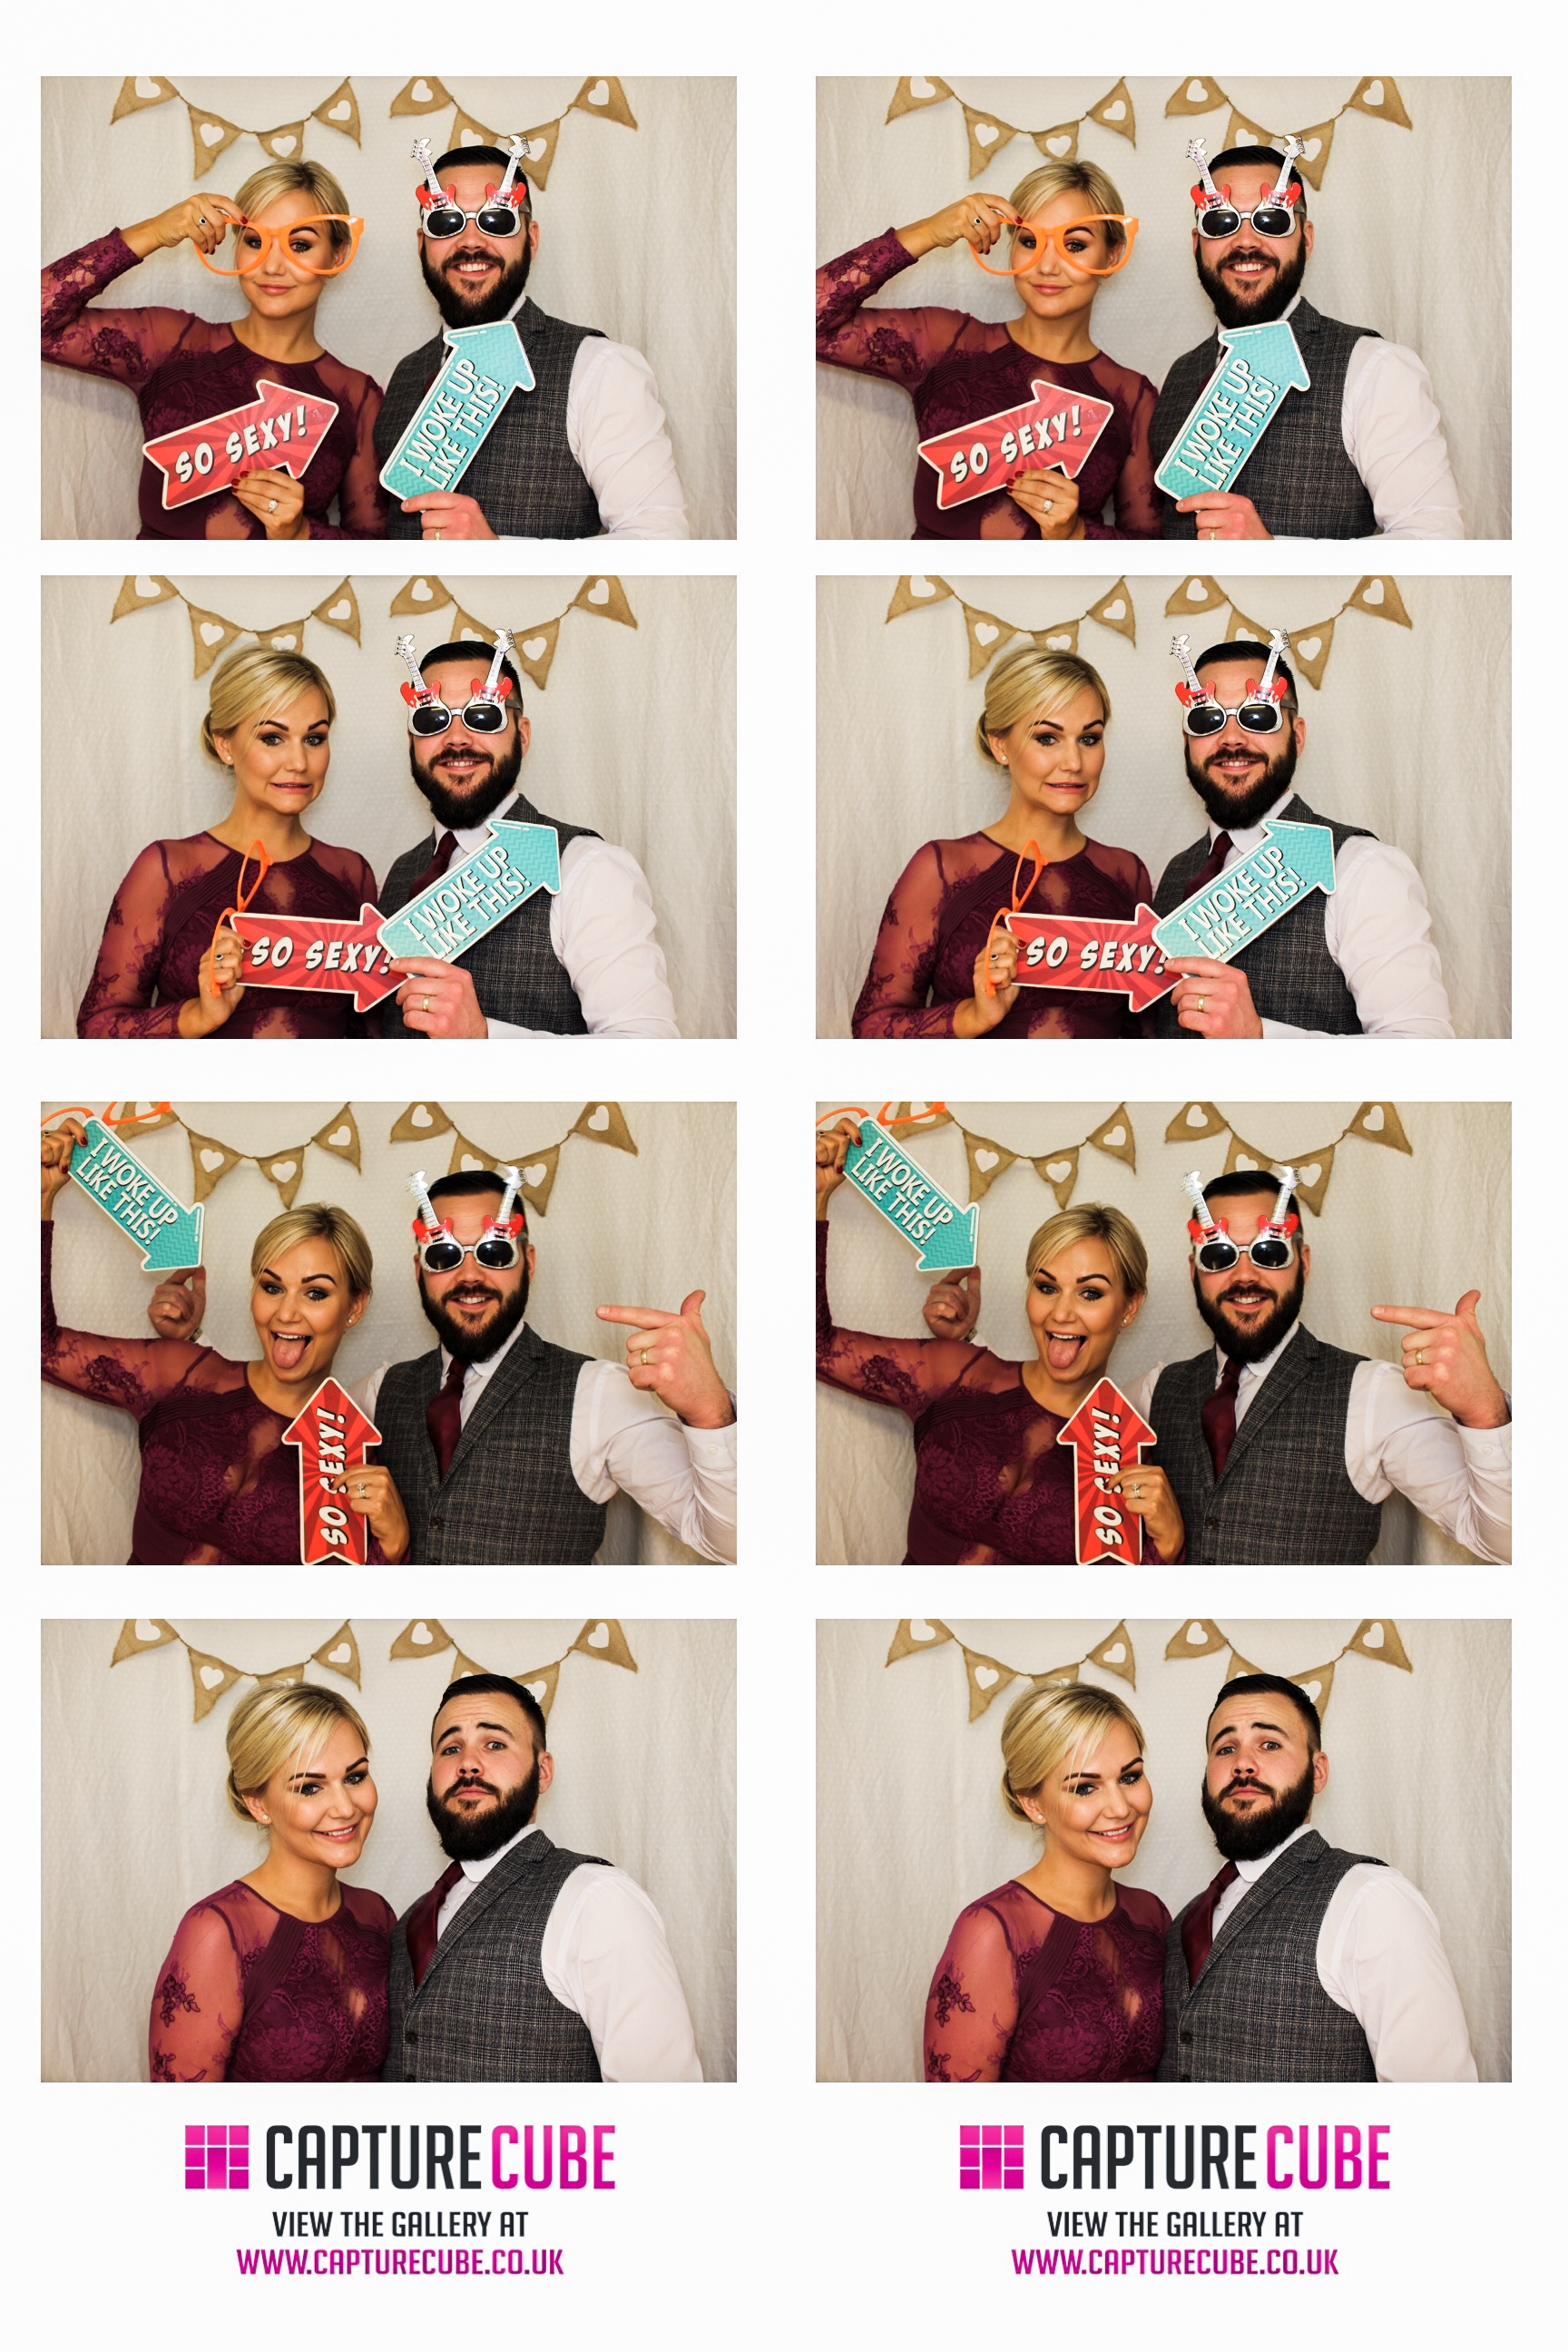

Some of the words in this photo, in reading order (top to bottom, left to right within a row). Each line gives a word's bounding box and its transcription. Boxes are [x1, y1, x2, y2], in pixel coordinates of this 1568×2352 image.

[446, 358, 480, 395] UP
[1221, 358, 1255, 395] UP
[175, 442, 214, 483] SO
[225, 405, 307, 464] SEXY!
[406, 391, 465, 463] WOKE
[423, 437, 469, 490] LIKE
[452, 375, 506, 438] THIS!
[950, 442, 989, 483] SO
[1000, 405, 1082, 464] SEXY!
[1181, 391, 1240, 463] WOKE
[1198, 437, 1244, 490] LIKE
[1227, 375, 1281, 438] THIS!
[399, 457, 425, 477] I
[1174, 457, 1200, 477] I
[475, 846, 510, 879] UP
[1250, 846, 1285, 879] UP
[403, 917, 426, 941] I
[413, 868, 487, 930] WOKE
[422, 913, 477, 960] LIKE
[467, 867, 532, 921] THIS!
[1178, 917, 1200, 941] I
[1188, 868, 1262, 930] WOKE
[1197, 913, 1252, 960] LIKE
[1242, 867, 1307, 921] THIS!
[251, 936, 294, 967] SO
[1026, 936, 1069, 967] SO
[76, 1156, 118, 1201] LIKE
[113, 1191, 162, 1246] THIS!
[90, 1137, 108, 1158] I
[101, 1145, 155, 1207] WOKE
[149, 1195, 179, 1226] UP
[851, 1156, 893, 1201] LIKE
[887, 1191, 936, 1246] THIS!
[865, 1137, 883, 1158] I
[876, 1145, 930, 1207] WOKE
[924, 1195, 954, 1226] UP
[318, 1504, 348, 1545] SO
[1093, 1504, 1123, 1545] SO
